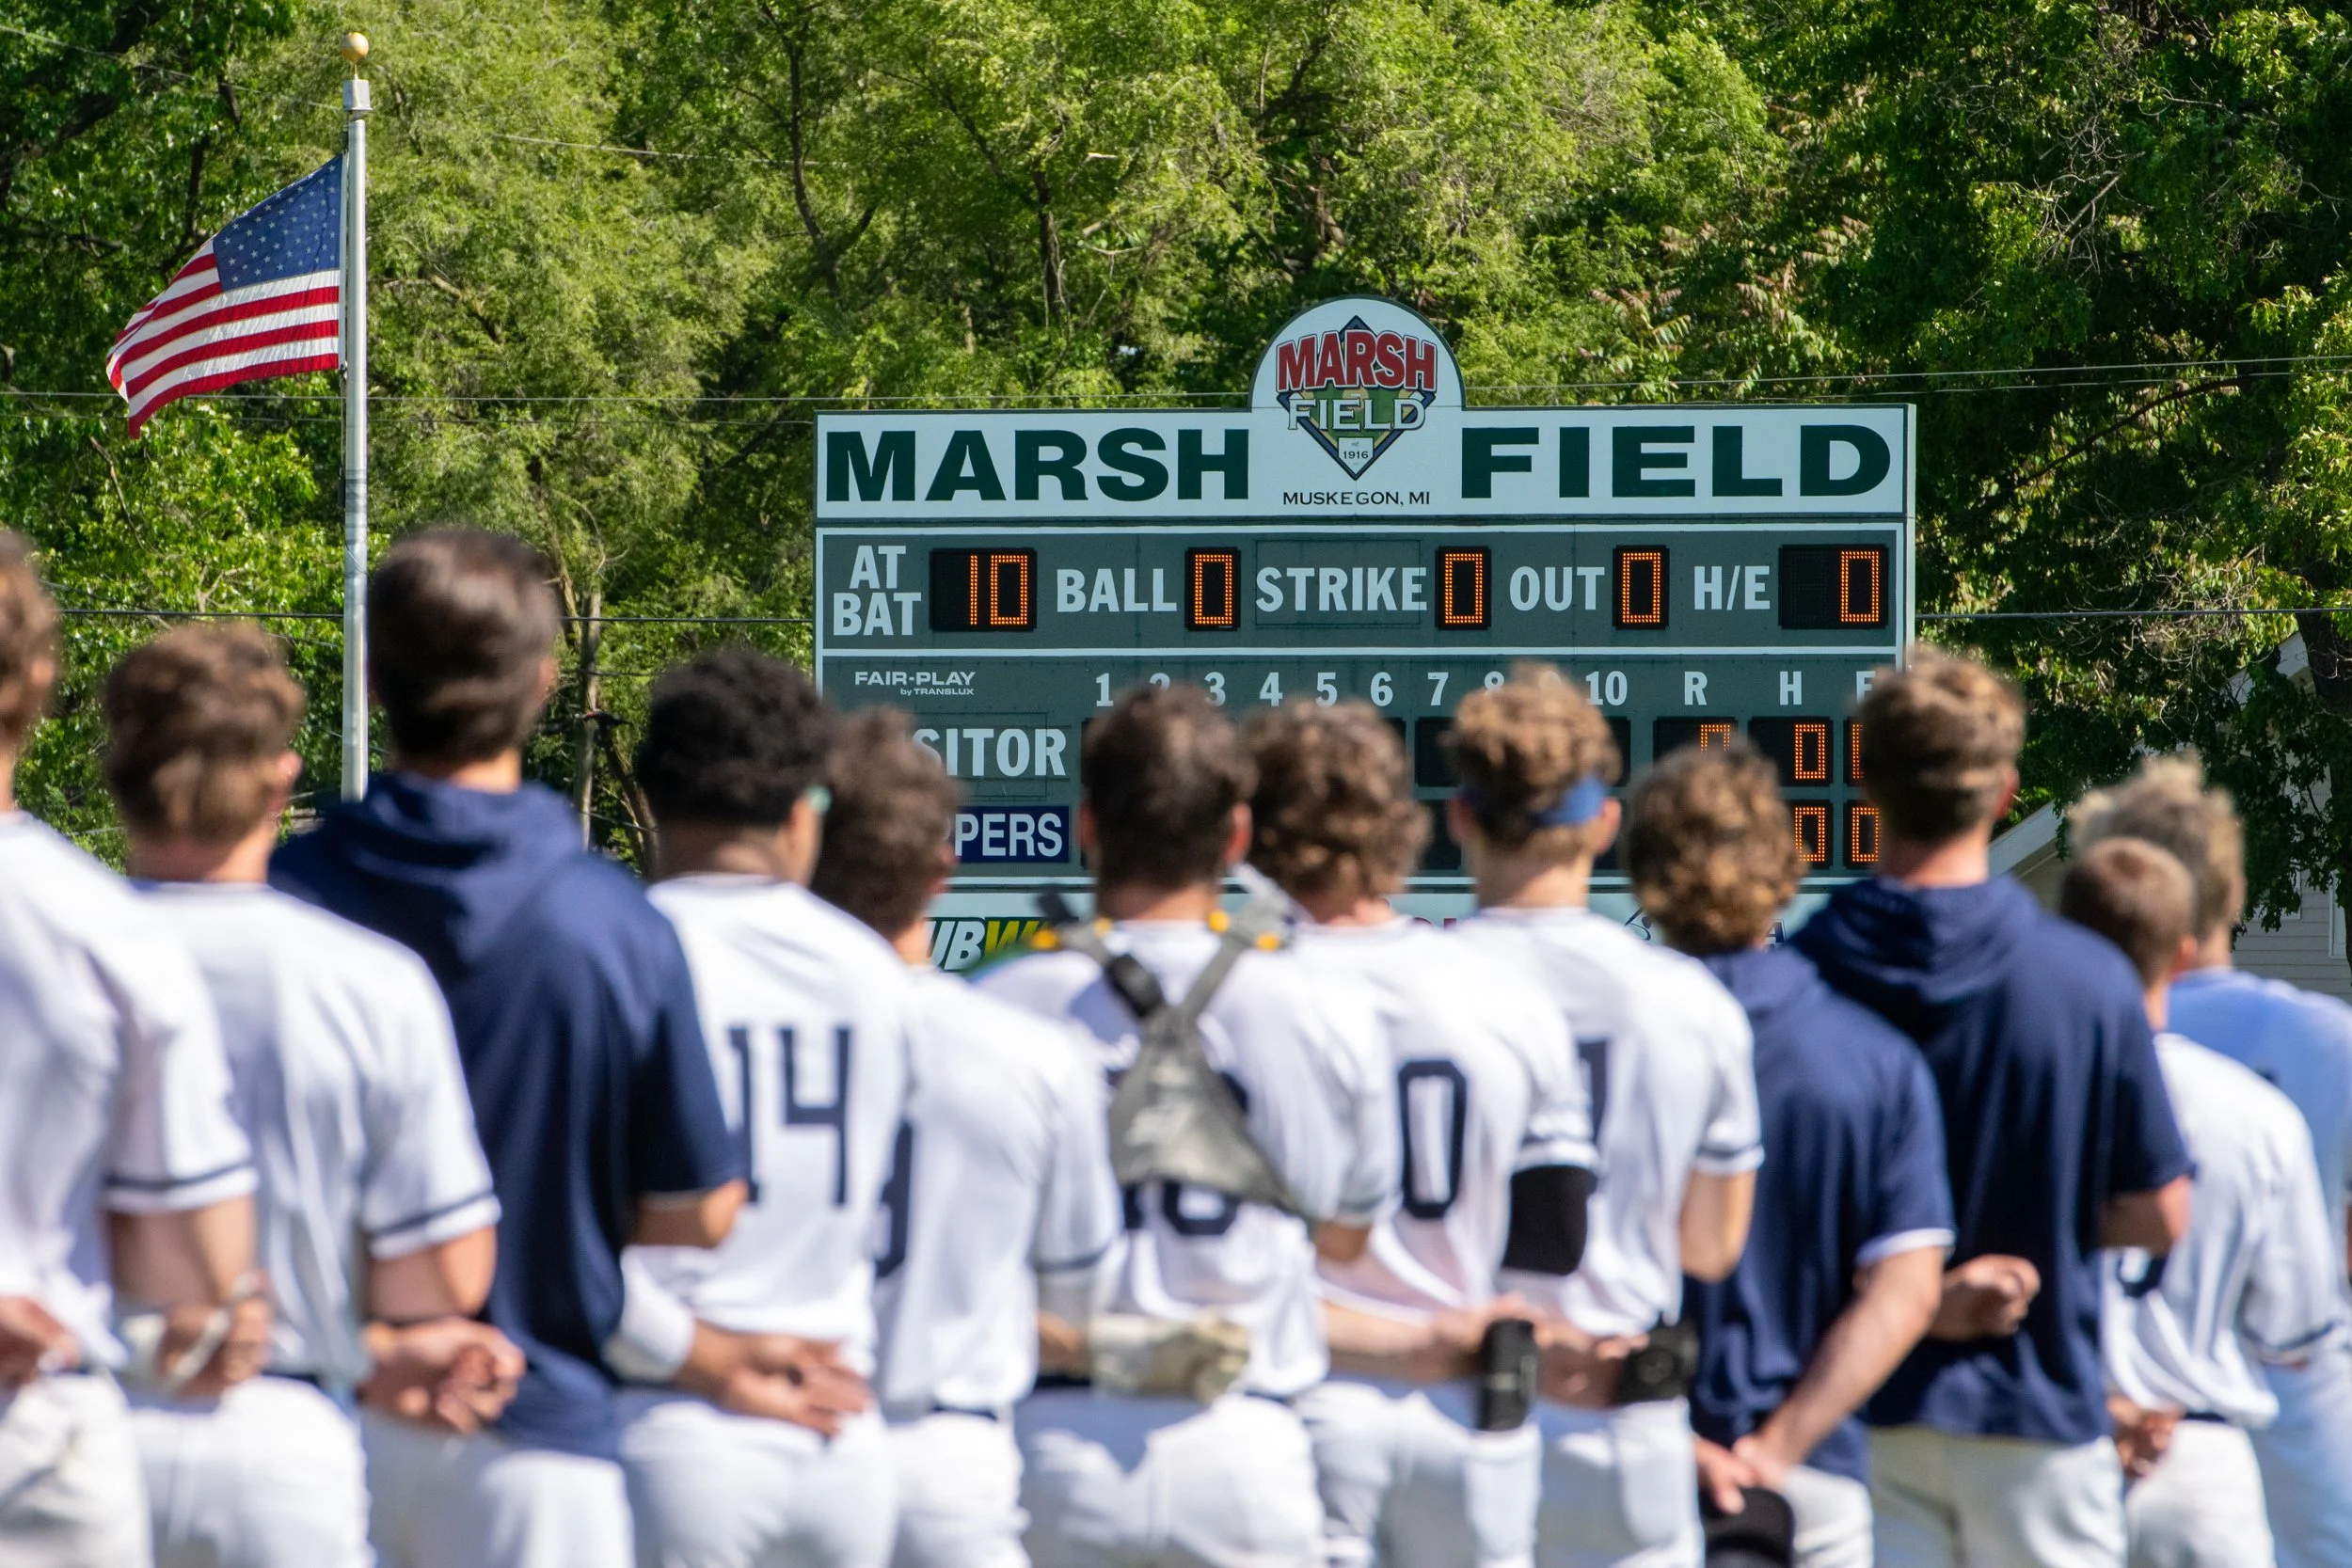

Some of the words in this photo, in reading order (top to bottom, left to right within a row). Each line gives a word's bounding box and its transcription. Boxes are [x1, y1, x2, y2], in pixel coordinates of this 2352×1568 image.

[1277, 329, 1438, 393] MARSH
[1288, 397, 1426, 432] FIELD
[826, 427, 1249, 501] MARSH
[1461, 424, 1891, 499] FIELD
[1343, 451, 1370, 459] 1916
[1283, 491, 1405, 507] MUSKEGON,
[1409, 491, 1430, 505] MI
[850, 545, 906, 589] AT
[969, 553, 1028, 626] 10
[1057, 568, 1177, 612] BALL
[1194, 553, 1233, 626] 0
[1256, 566, 1427, 612] STRIKE
[1444, 552, 1484, 625] 0
[1509, 565, 1605, 611] OUT
[1621, 551, 1661, 624] 0
[1695, 564, 1770, 610] H/E
[1840, 550, 1880, 623] 0
[833, 592, 921, 636] BAT
[854, 671, 976, 686] FAIR-PLAY
[900, 688, 912, 696] by
[1095, 673, 1114, 706] 1
[1203, 672, 1226, 706] 3
[1259, 672, 1282, 706] 4
[1315, 672, 1338, 706] 5
[1370, 672, 1393, 706] 6
[1427, 672, 1449, 705] 7
[1585, 671, 1628, 705] 10
[1684, 671, 1708, 705] R
[1779, 671, 1803, 705] H
[911, 728, 1067, 776] SITOR
[1794, 723, 1825, 780] 0
[1794, 807, 1825, 862] 0
